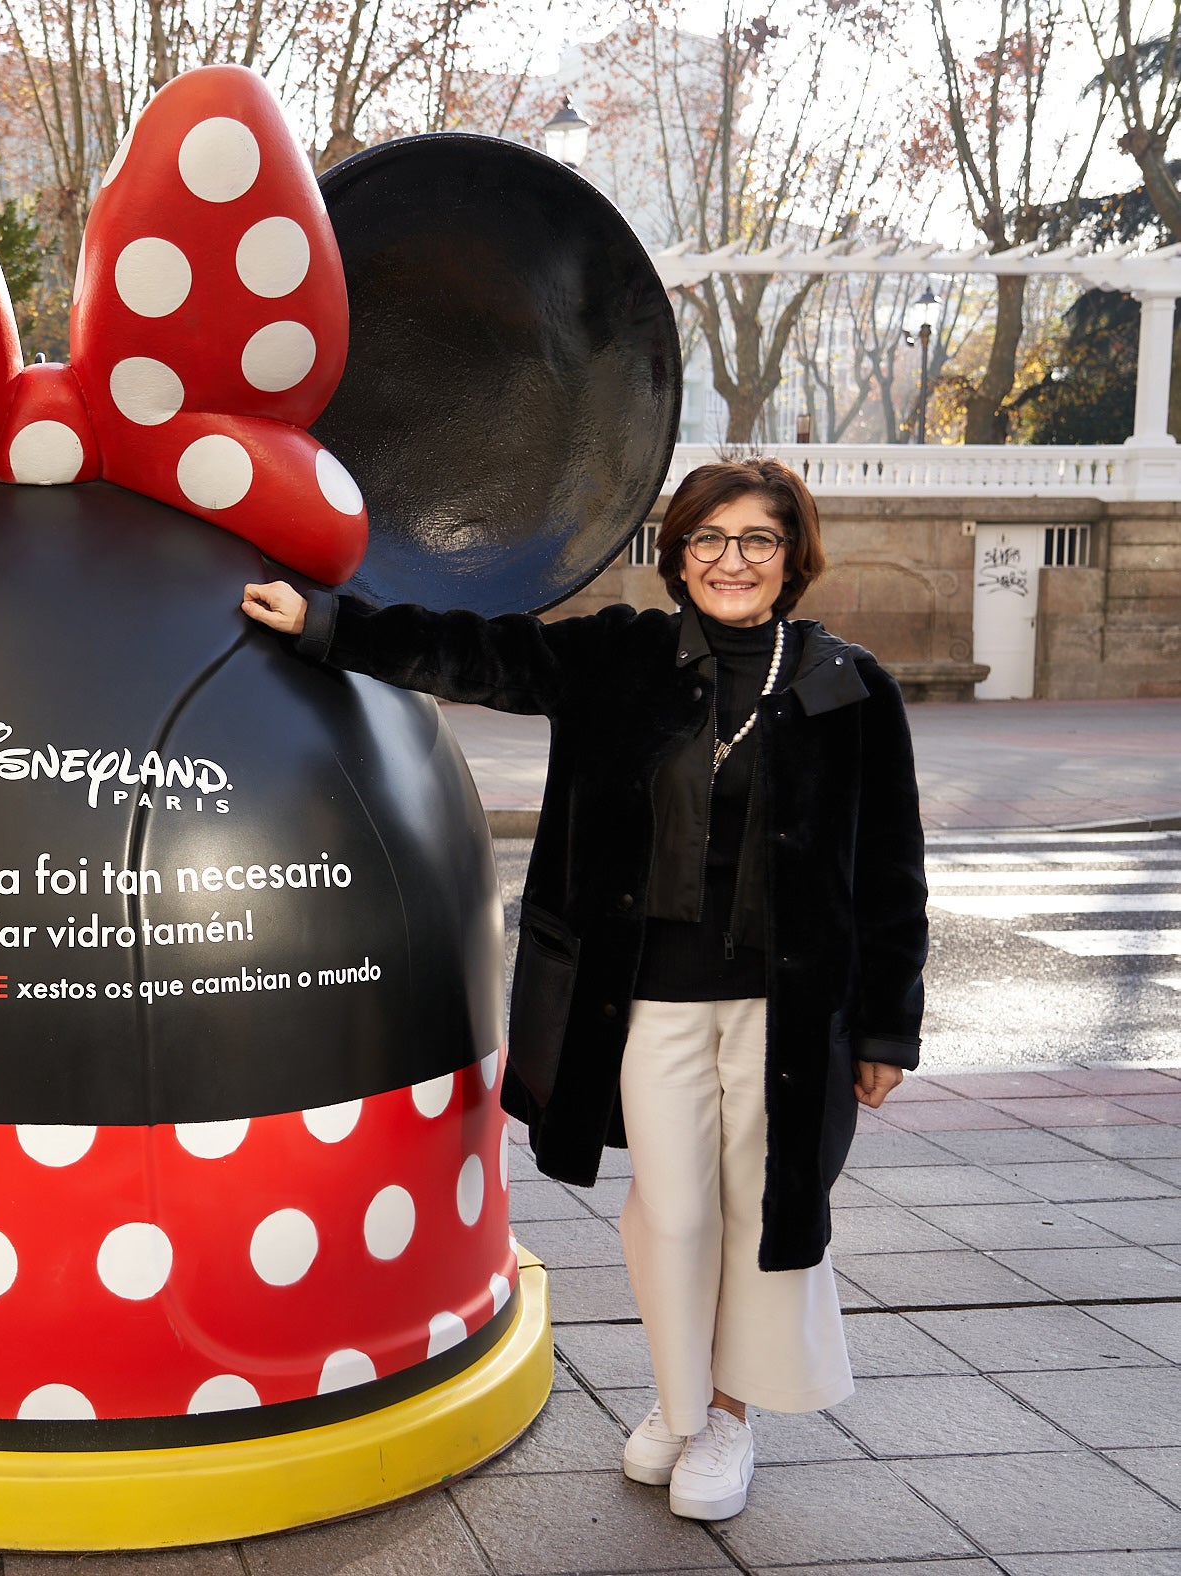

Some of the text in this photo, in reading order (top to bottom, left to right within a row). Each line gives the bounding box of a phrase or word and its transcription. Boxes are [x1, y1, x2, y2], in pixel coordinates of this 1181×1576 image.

[113, 790, 231, 815] PARIS
[34, 852, 89, 896] foi
[102, 861, 162, 895] tan
[176, 851, 352, 893] necesario
[46, 913, 136, 949] vidro
[142, 909, 254, 946] tamén!
[16, 978, 97, 1000] xestos
[104, 982, 133, 999] os
[139, 979, 184, 1005] que
[191, 966, 291, 995] cambian
[297, 971, 312, 988] o
[318, 956, 381, 986] mundo
